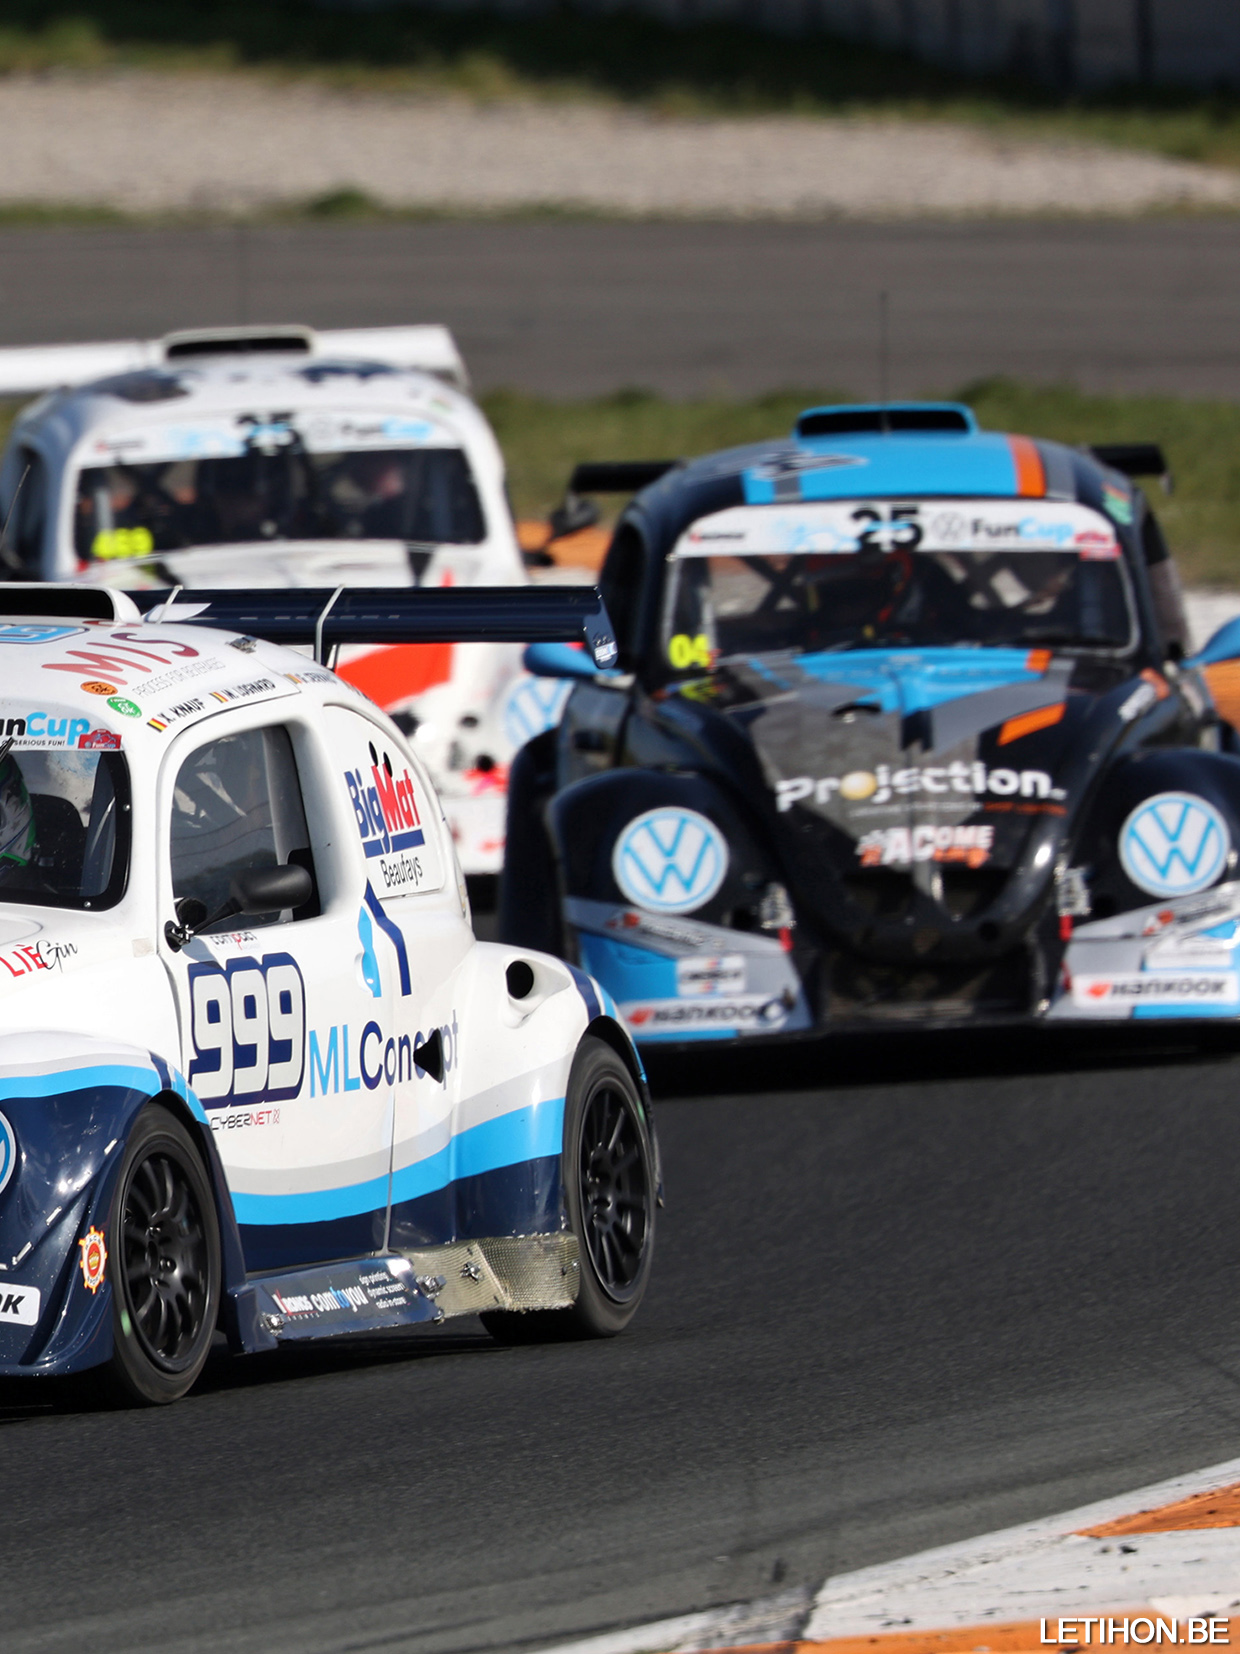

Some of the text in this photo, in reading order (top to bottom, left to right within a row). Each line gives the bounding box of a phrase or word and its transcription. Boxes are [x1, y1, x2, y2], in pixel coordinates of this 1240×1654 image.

[850, 506, 924, 552] 25
[344, 764, 423, 854] BigMat
[380, 854, 423, 889] Beaufays
[189, 956, 306, 1110] 999
